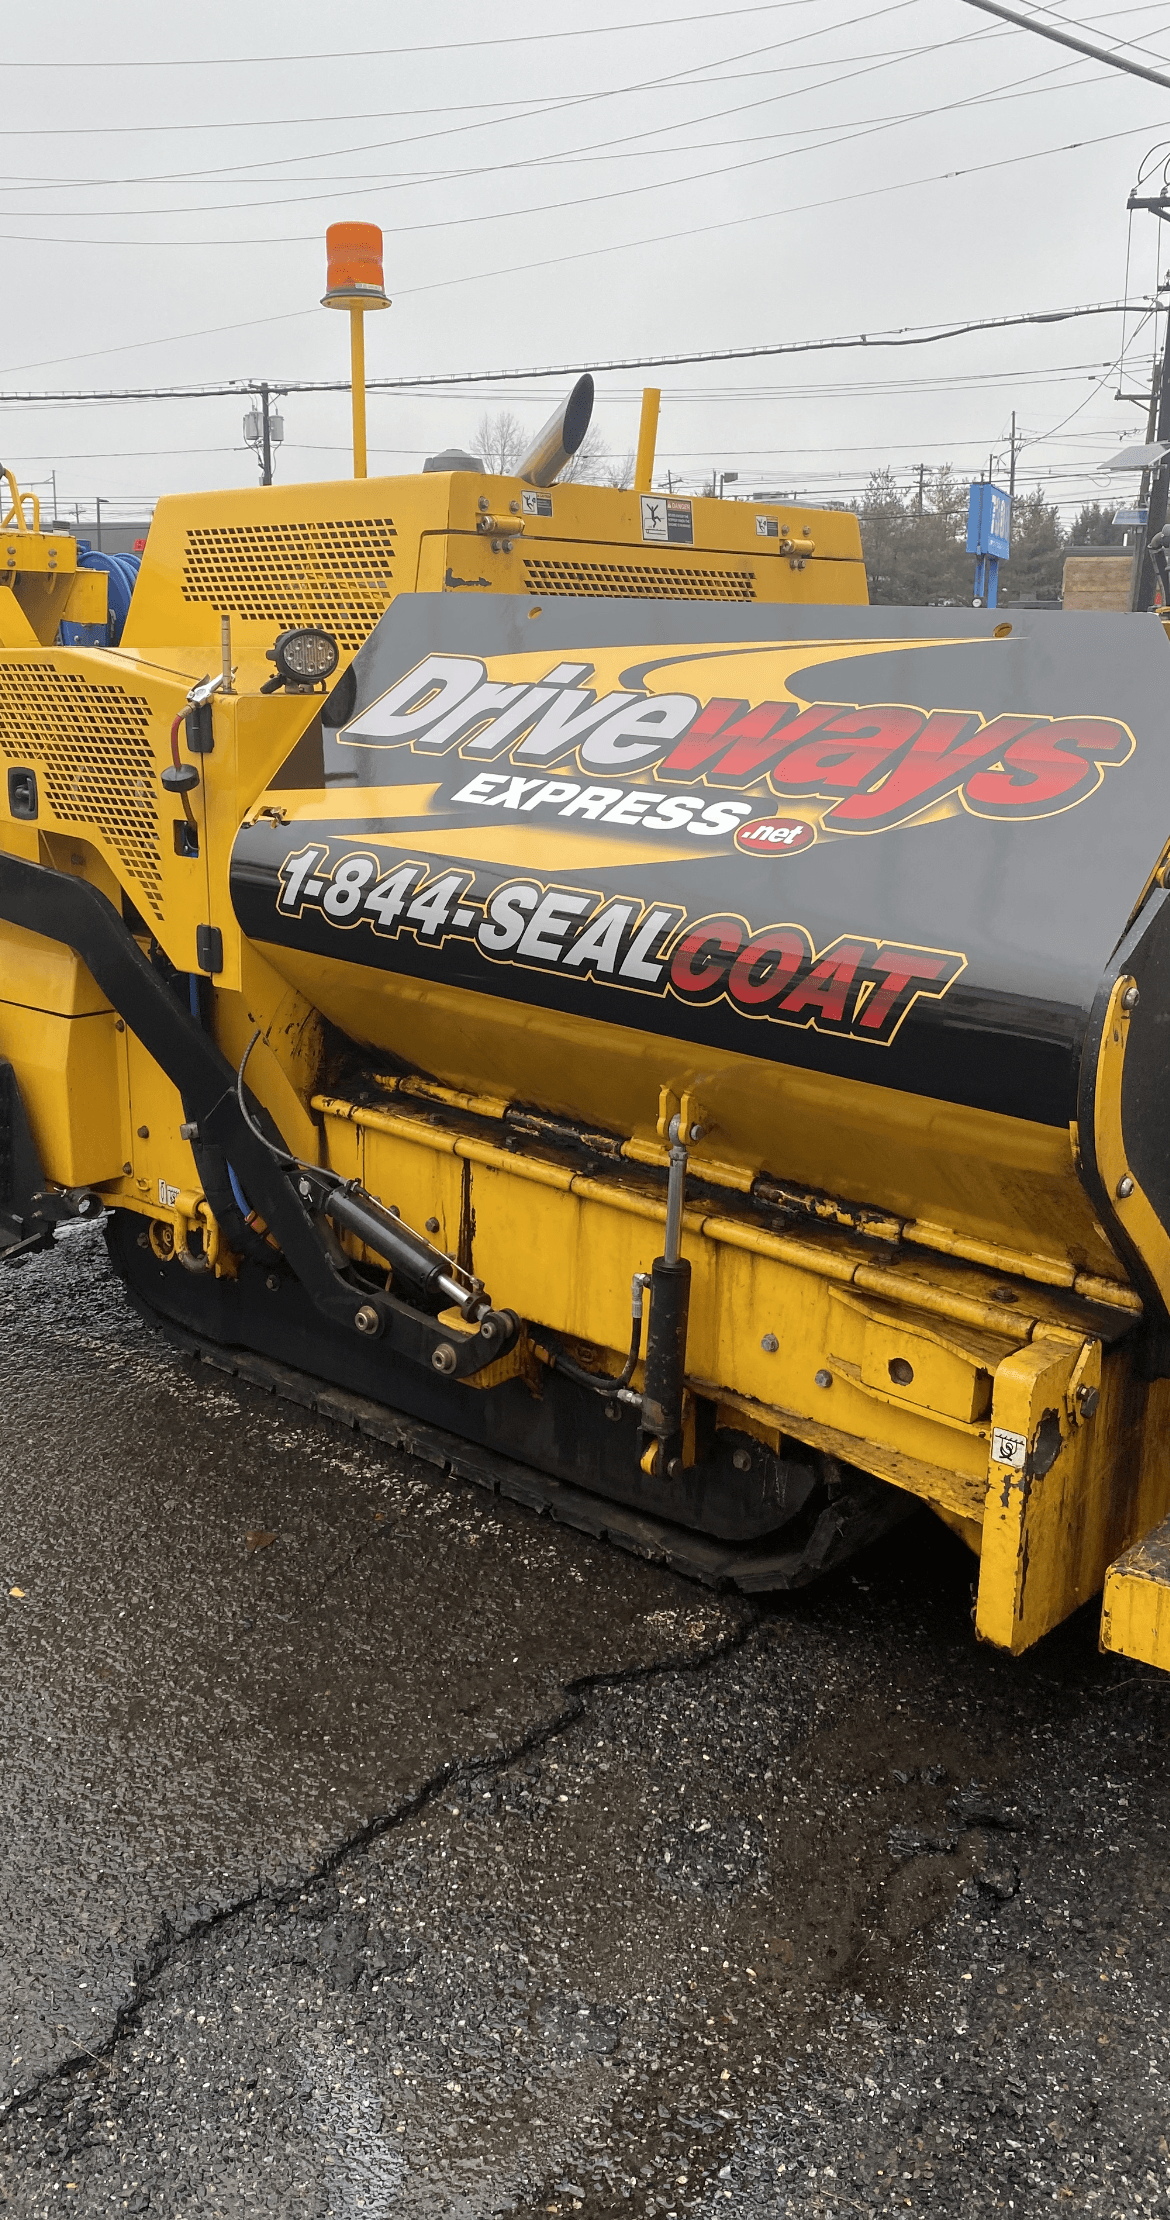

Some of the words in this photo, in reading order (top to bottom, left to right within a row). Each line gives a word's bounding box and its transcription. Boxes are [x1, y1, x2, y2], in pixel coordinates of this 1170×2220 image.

[343, 655, 1125, 824] Driveways
[450, 772, 753, 836] EXPRESS
[740, 825, 805, 845] .net
[281, 849, 949, 1030] 1-844-SEALCOAT
